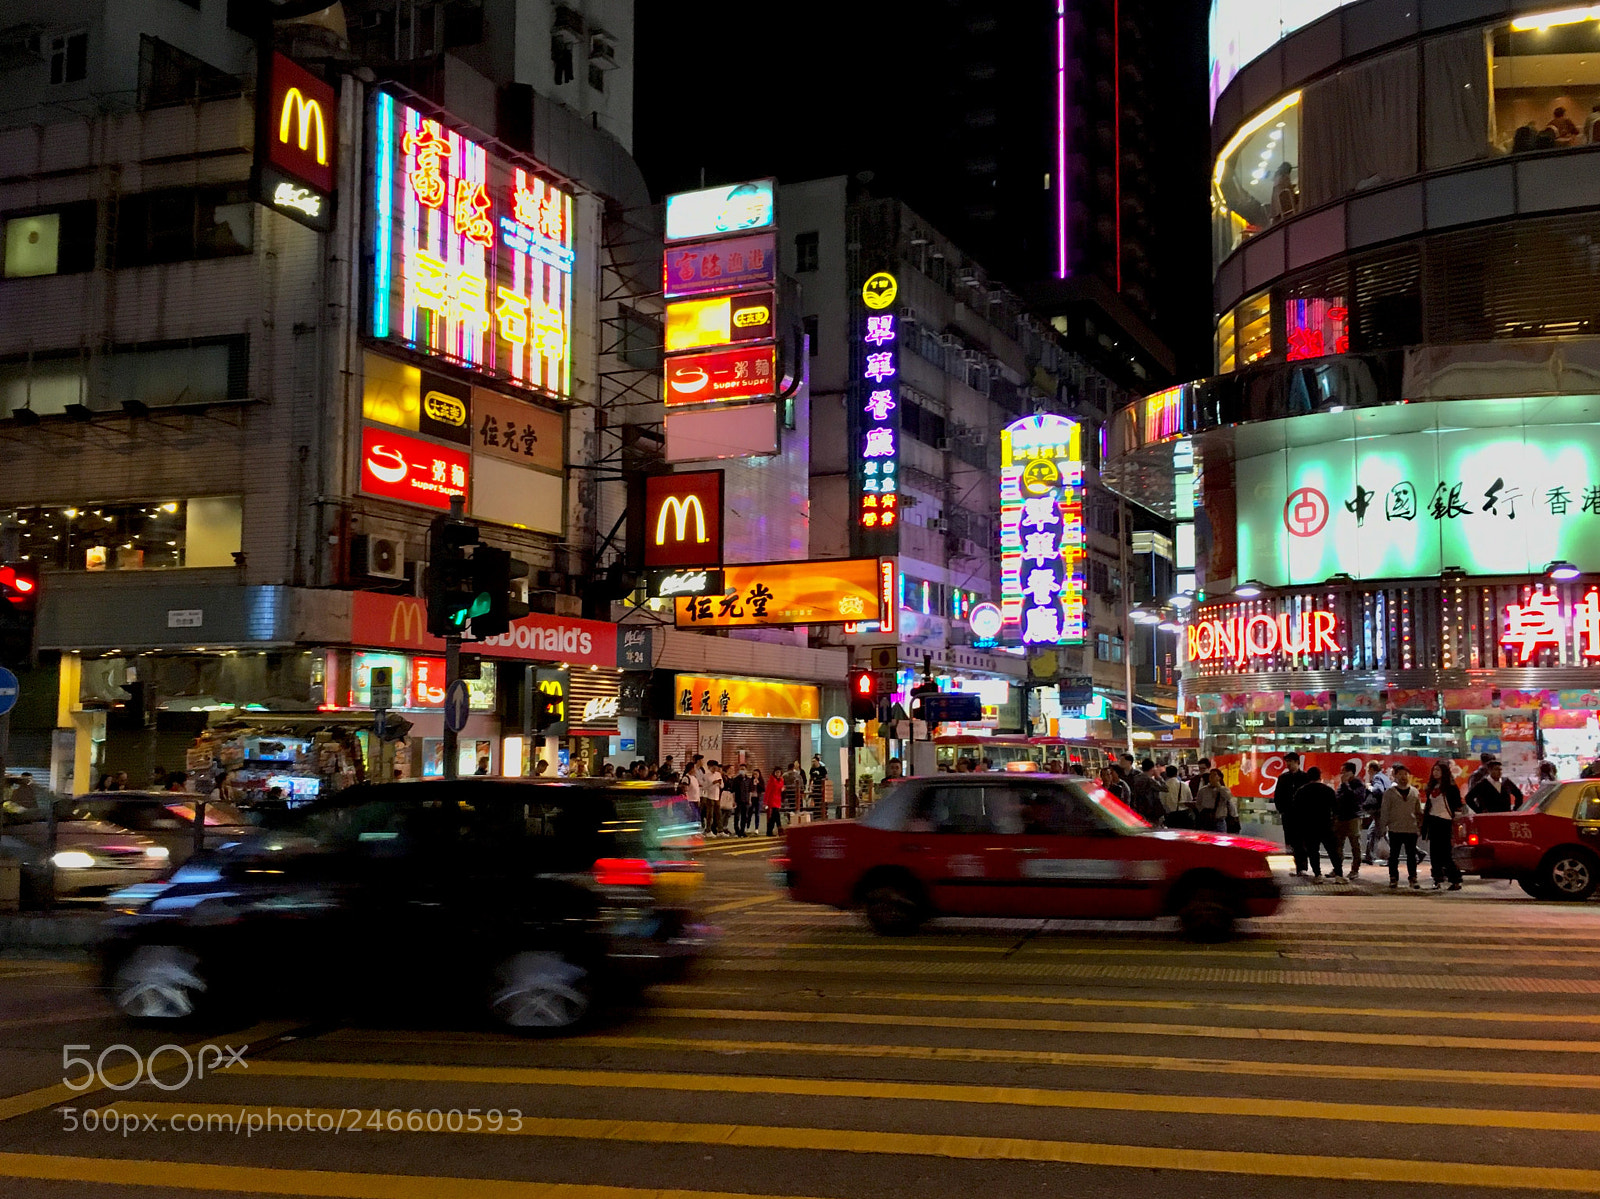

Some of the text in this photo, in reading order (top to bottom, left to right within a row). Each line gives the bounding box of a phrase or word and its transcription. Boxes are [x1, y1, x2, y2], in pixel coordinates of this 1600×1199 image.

[713, 378, 769, 390] Super Super
[480, 414, 538, 457] 位元堂
[411, 478, 464, 496] Super Super
[1187, 610, 1341, 667] BONJOUR
[680, 689, 731, 713] 位元堂
[1409, 717, 1442, 726] BONJOUR
